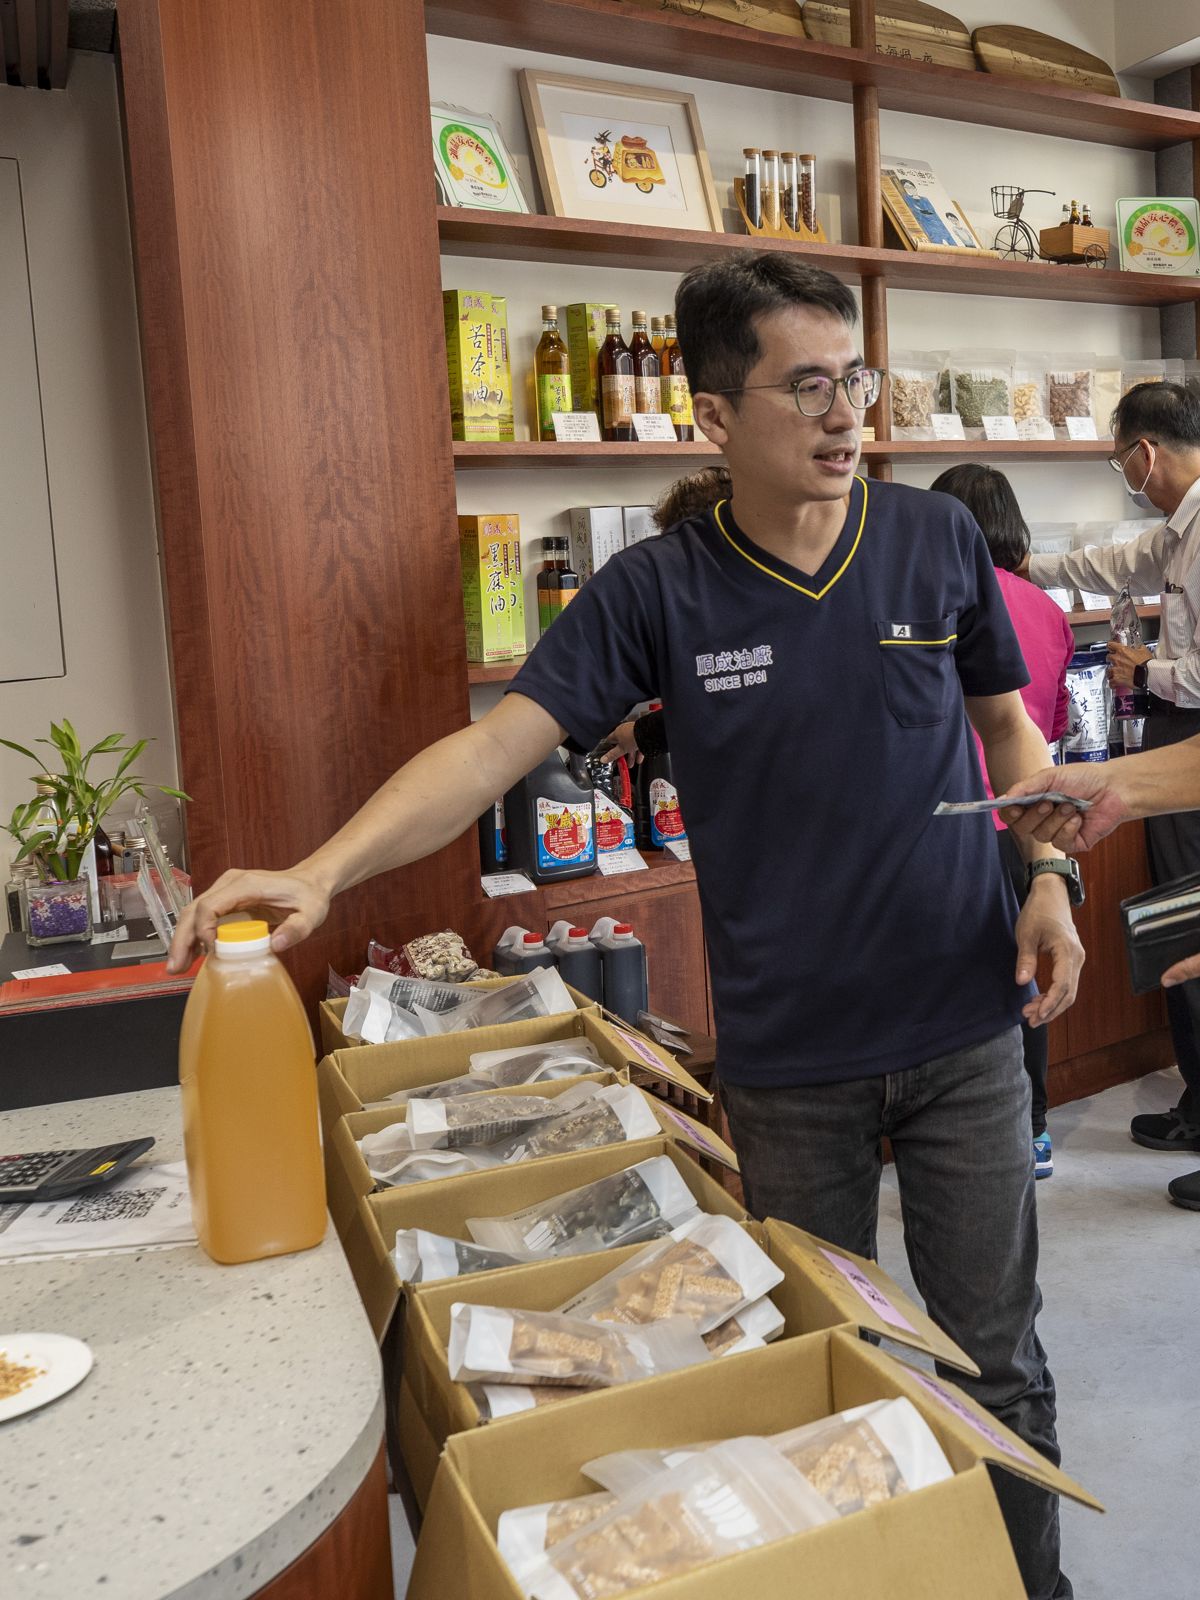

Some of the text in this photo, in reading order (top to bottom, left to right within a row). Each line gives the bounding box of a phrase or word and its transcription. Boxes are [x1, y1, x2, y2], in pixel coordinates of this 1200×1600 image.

[466, 324, 489, 403] 苦茶油
[486, 542, 506, 615] 黑麻油
[695, 644, 774, 677] 順成油廠
[704, 670, 768, 693] SINCE 1961
[658, 798, 680, 810] 黑麻
